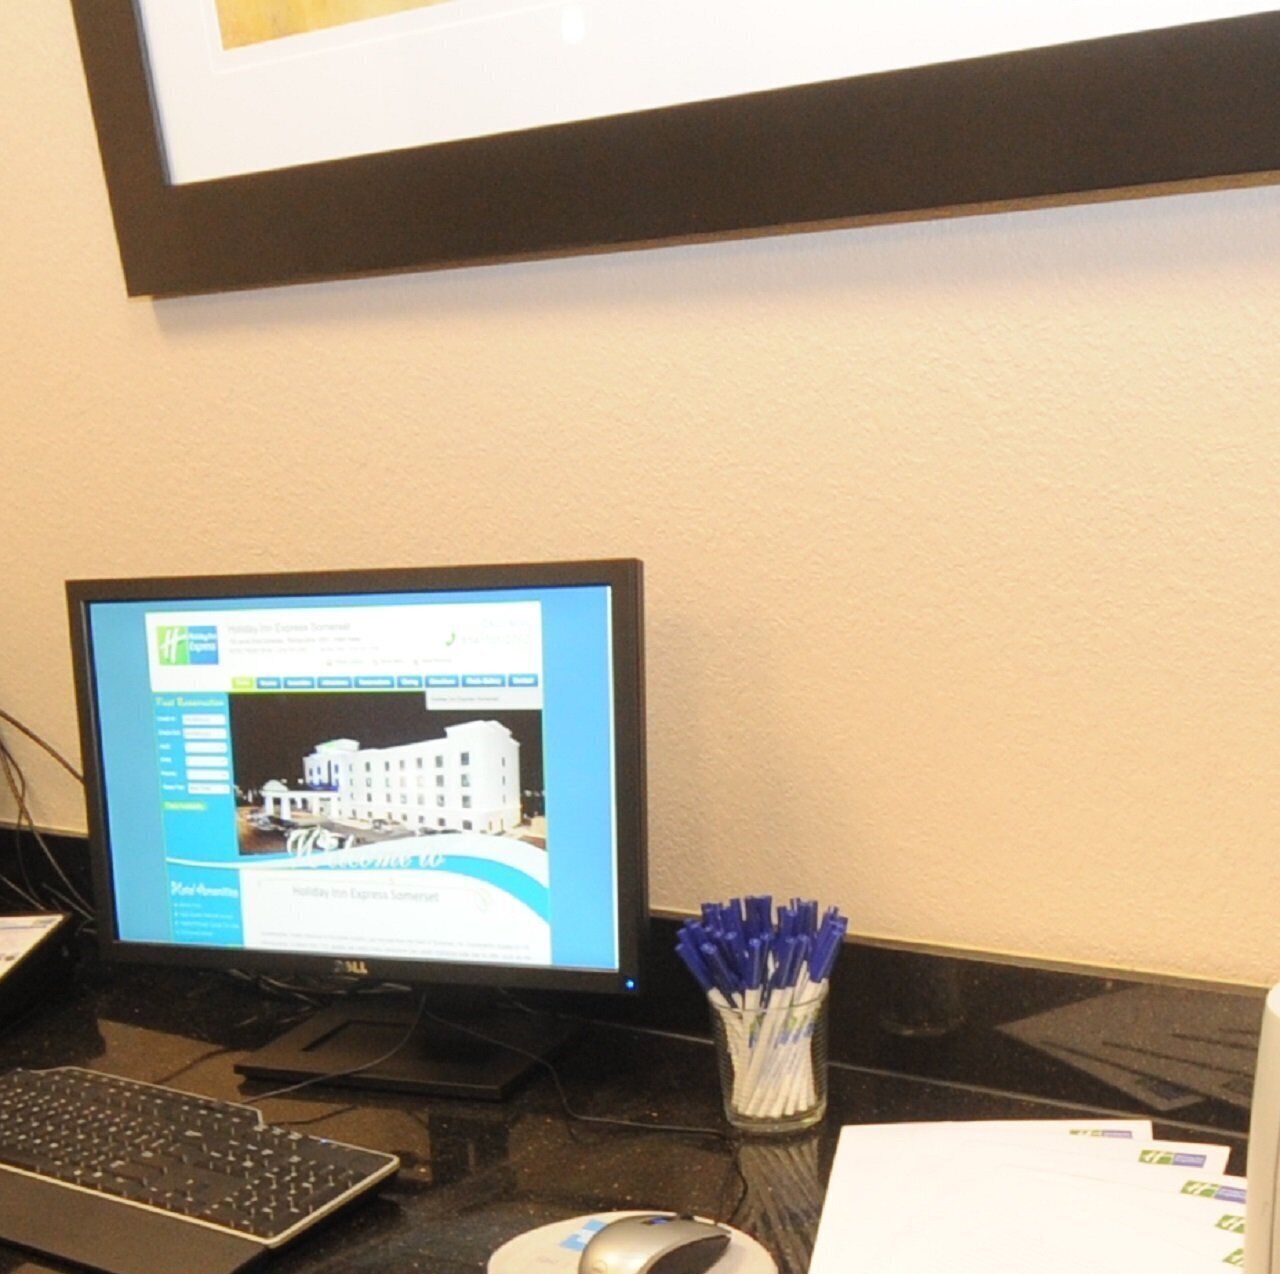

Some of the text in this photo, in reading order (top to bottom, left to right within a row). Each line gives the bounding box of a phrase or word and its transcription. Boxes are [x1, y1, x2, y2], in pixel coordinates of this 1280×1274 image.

[293, 886, 440, 903] Holiday Inn Express Somerset
